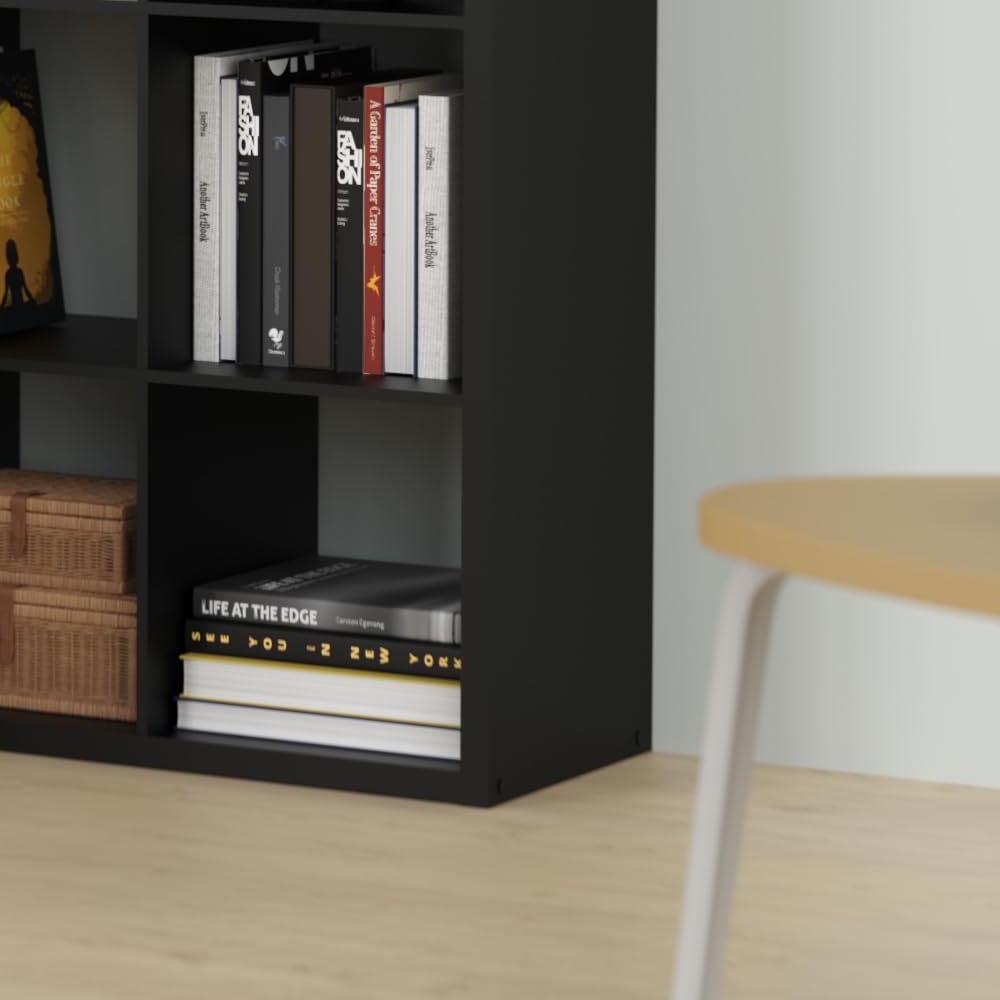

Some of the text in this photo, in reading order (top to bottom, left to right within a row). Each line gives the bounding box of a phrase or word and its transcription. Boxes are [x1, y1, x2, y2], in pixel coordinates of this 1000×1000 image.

[366, 99, 382, 247] A Garden of Paper Cranes
[200, 182, 211, 242] Another ArtBook
[425, 211, 438, 268] Another ArtBook
[202, 599, 318, 625] LIFE AT THE EDGE
[191, 631, 462, 669] SEE YOU IN NEW YORK
